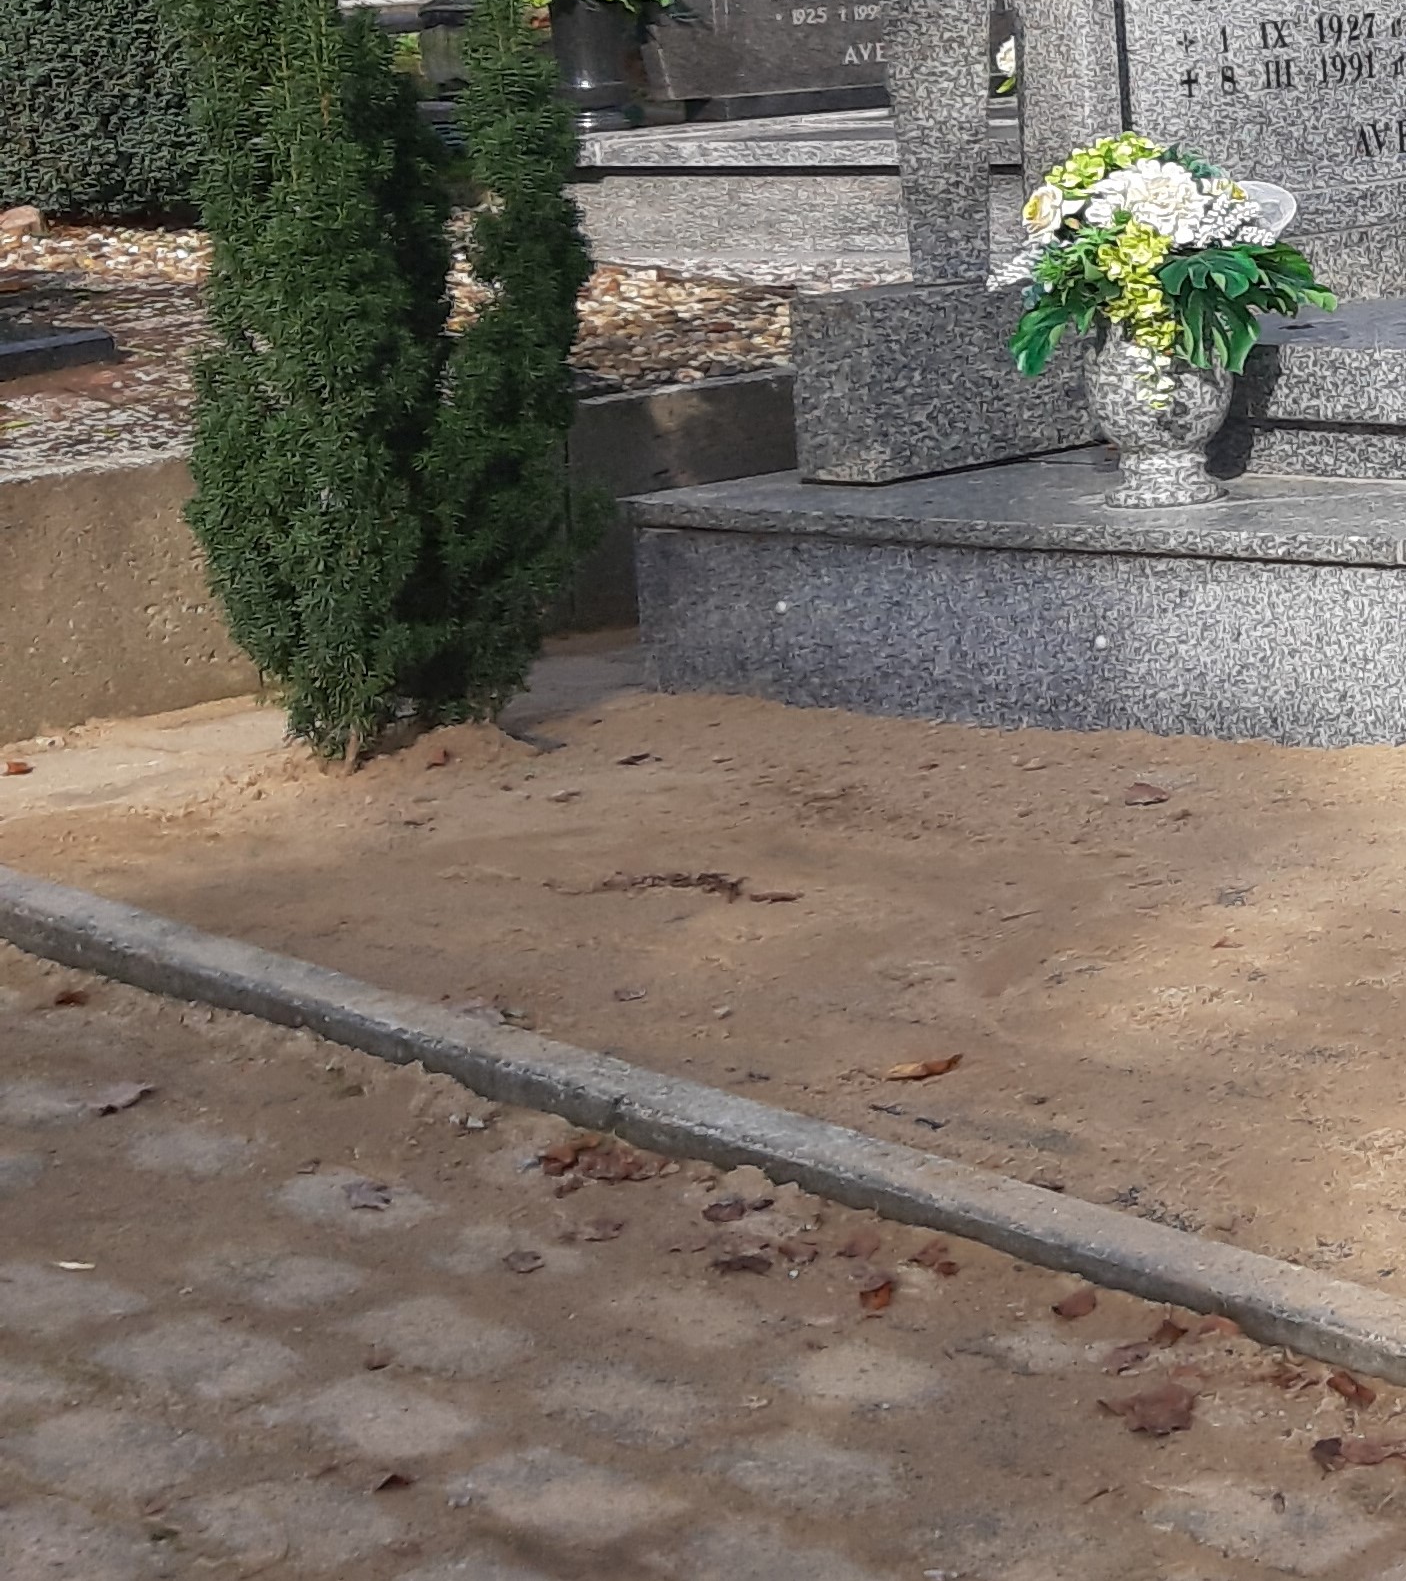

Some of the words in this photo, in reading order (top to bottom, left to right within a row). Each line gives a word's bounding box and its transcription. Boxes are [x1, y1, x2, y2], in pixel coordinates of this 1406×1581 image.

[854, 4, 880, 21] 199
[1261, 20, 1288, 49] IX
[1316, 13, 1376, 45] 1927
[842, 42, 888, 66] AVE
[1220, 65, 1237, 95] 8
[1264, 59, 1295, 89] III
[1316, 51, 1375, 84] 1991
